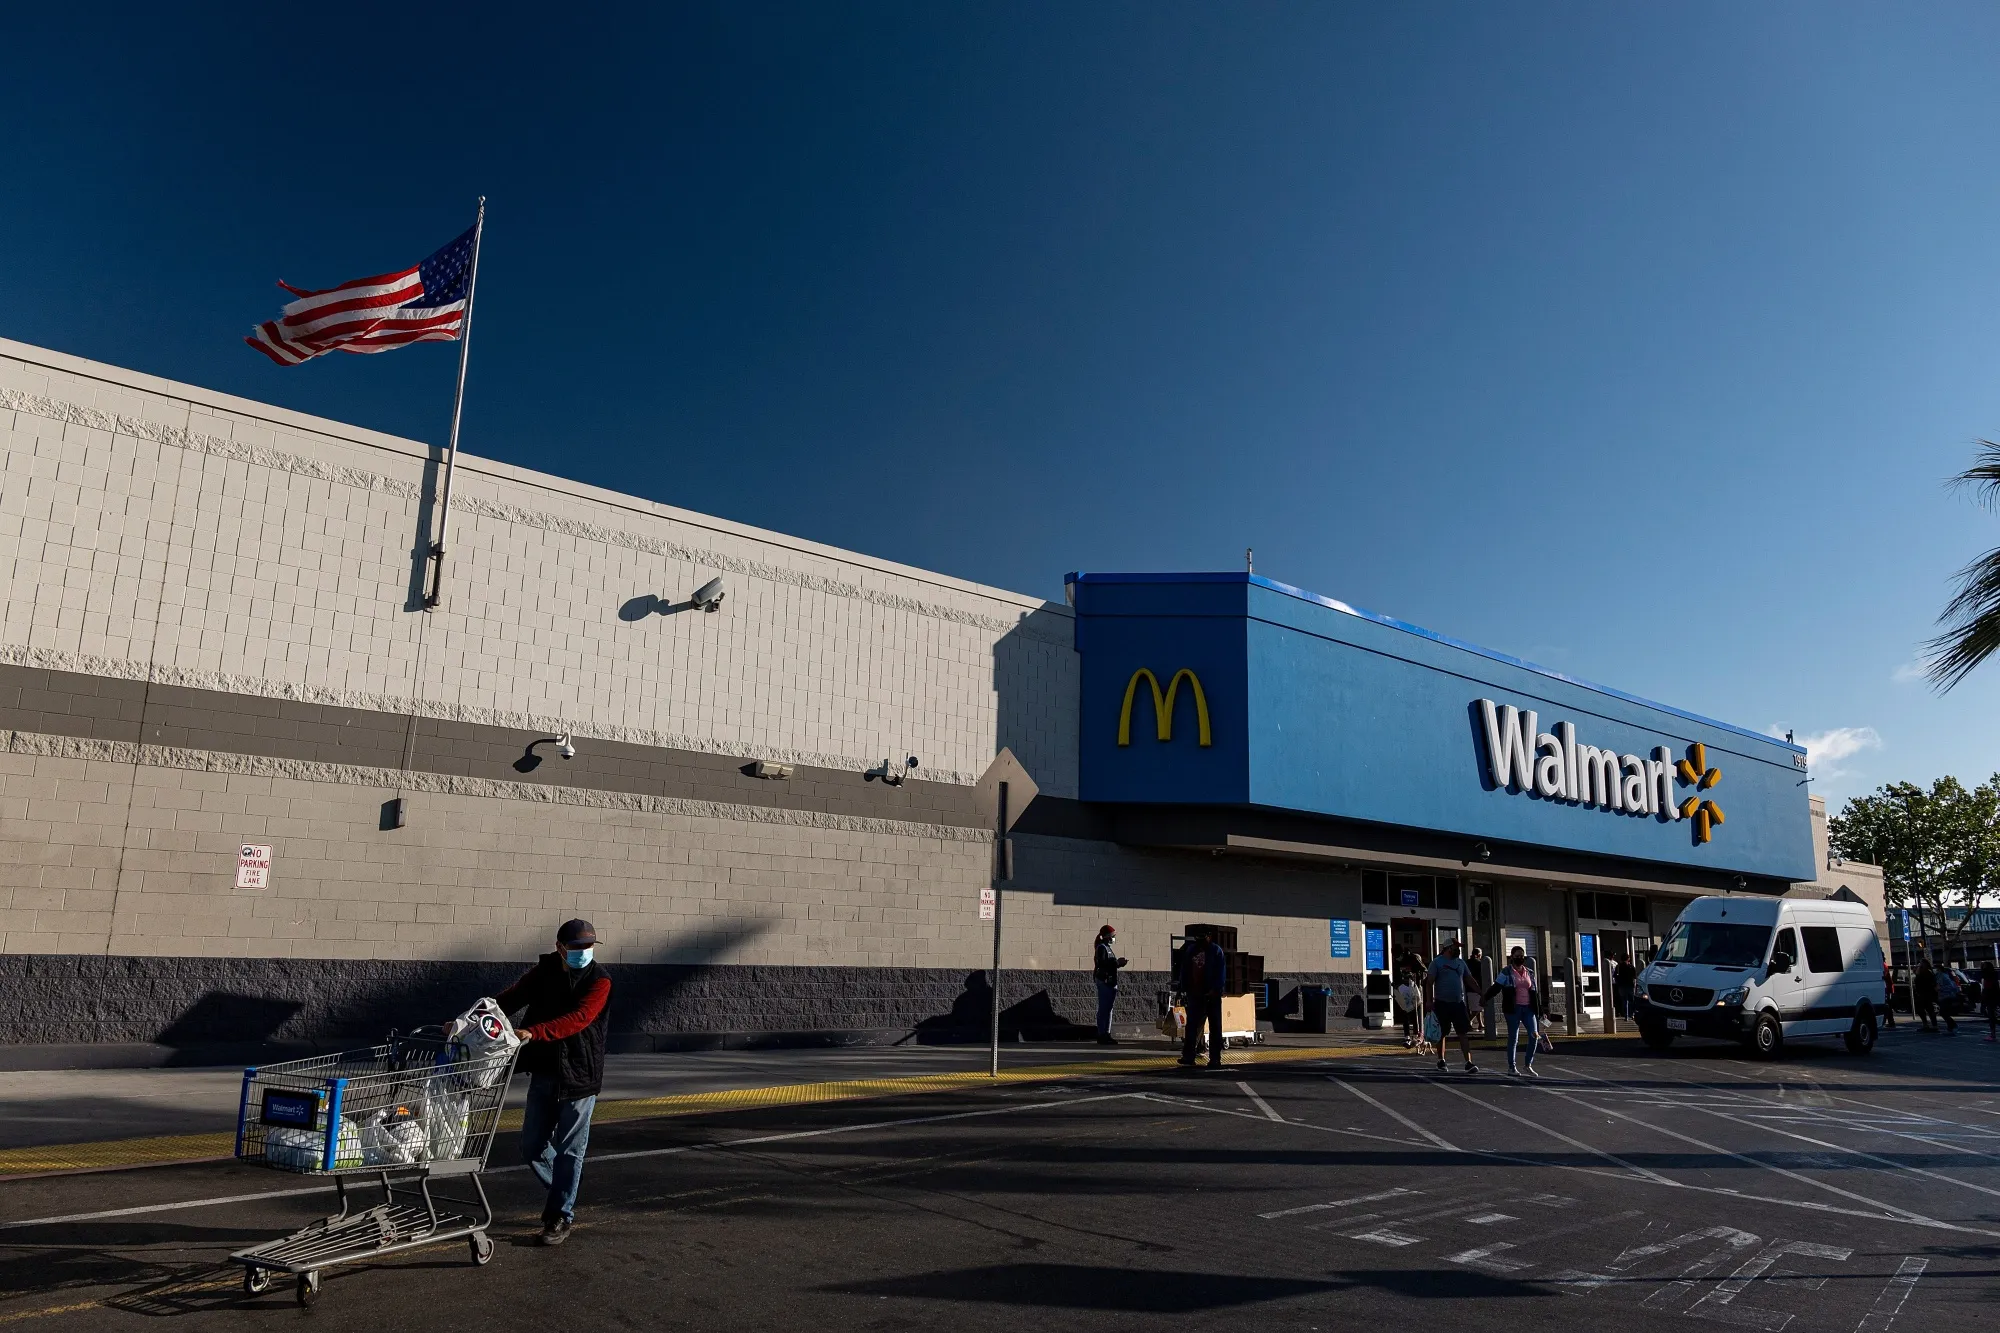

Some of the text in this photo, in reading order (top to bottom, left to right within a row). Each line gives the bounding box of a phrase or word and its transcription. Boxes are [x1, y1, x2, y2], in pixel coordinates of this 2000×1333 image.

[1481, 698, 1680, 820] Walmart
[240, 859, 269, 869] PARKING
[272, 1103, 296, 1113] Walmart
